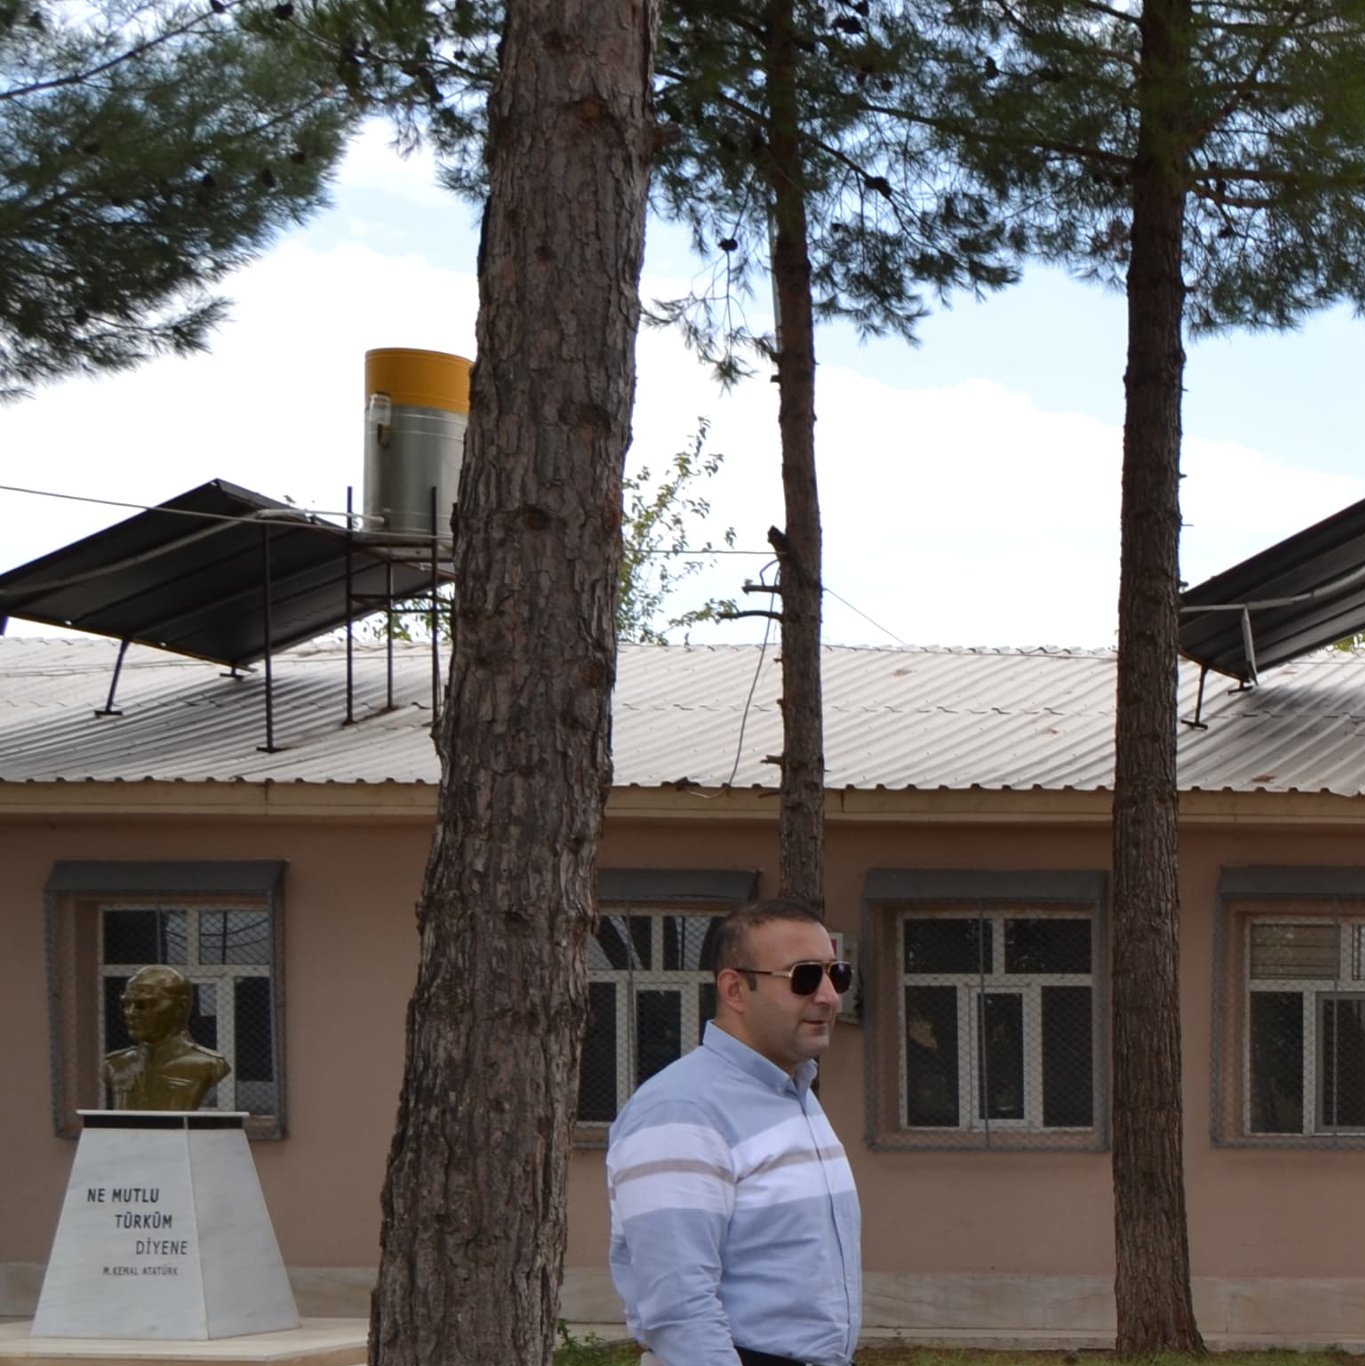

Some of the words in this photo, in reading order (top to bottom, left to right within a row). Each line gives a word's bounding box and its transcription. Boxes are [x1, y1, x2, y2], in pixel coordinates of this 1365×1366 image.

[87, 1188, 106, 1203] NE
[111, 1188, 160, 1203] MUTLU
[114, 1211, 173, 1229] TÜRKÜM
[135, 1237, 188, 1255] DİYENE
[142, 1264, 178, 1276] ATATÜRK
